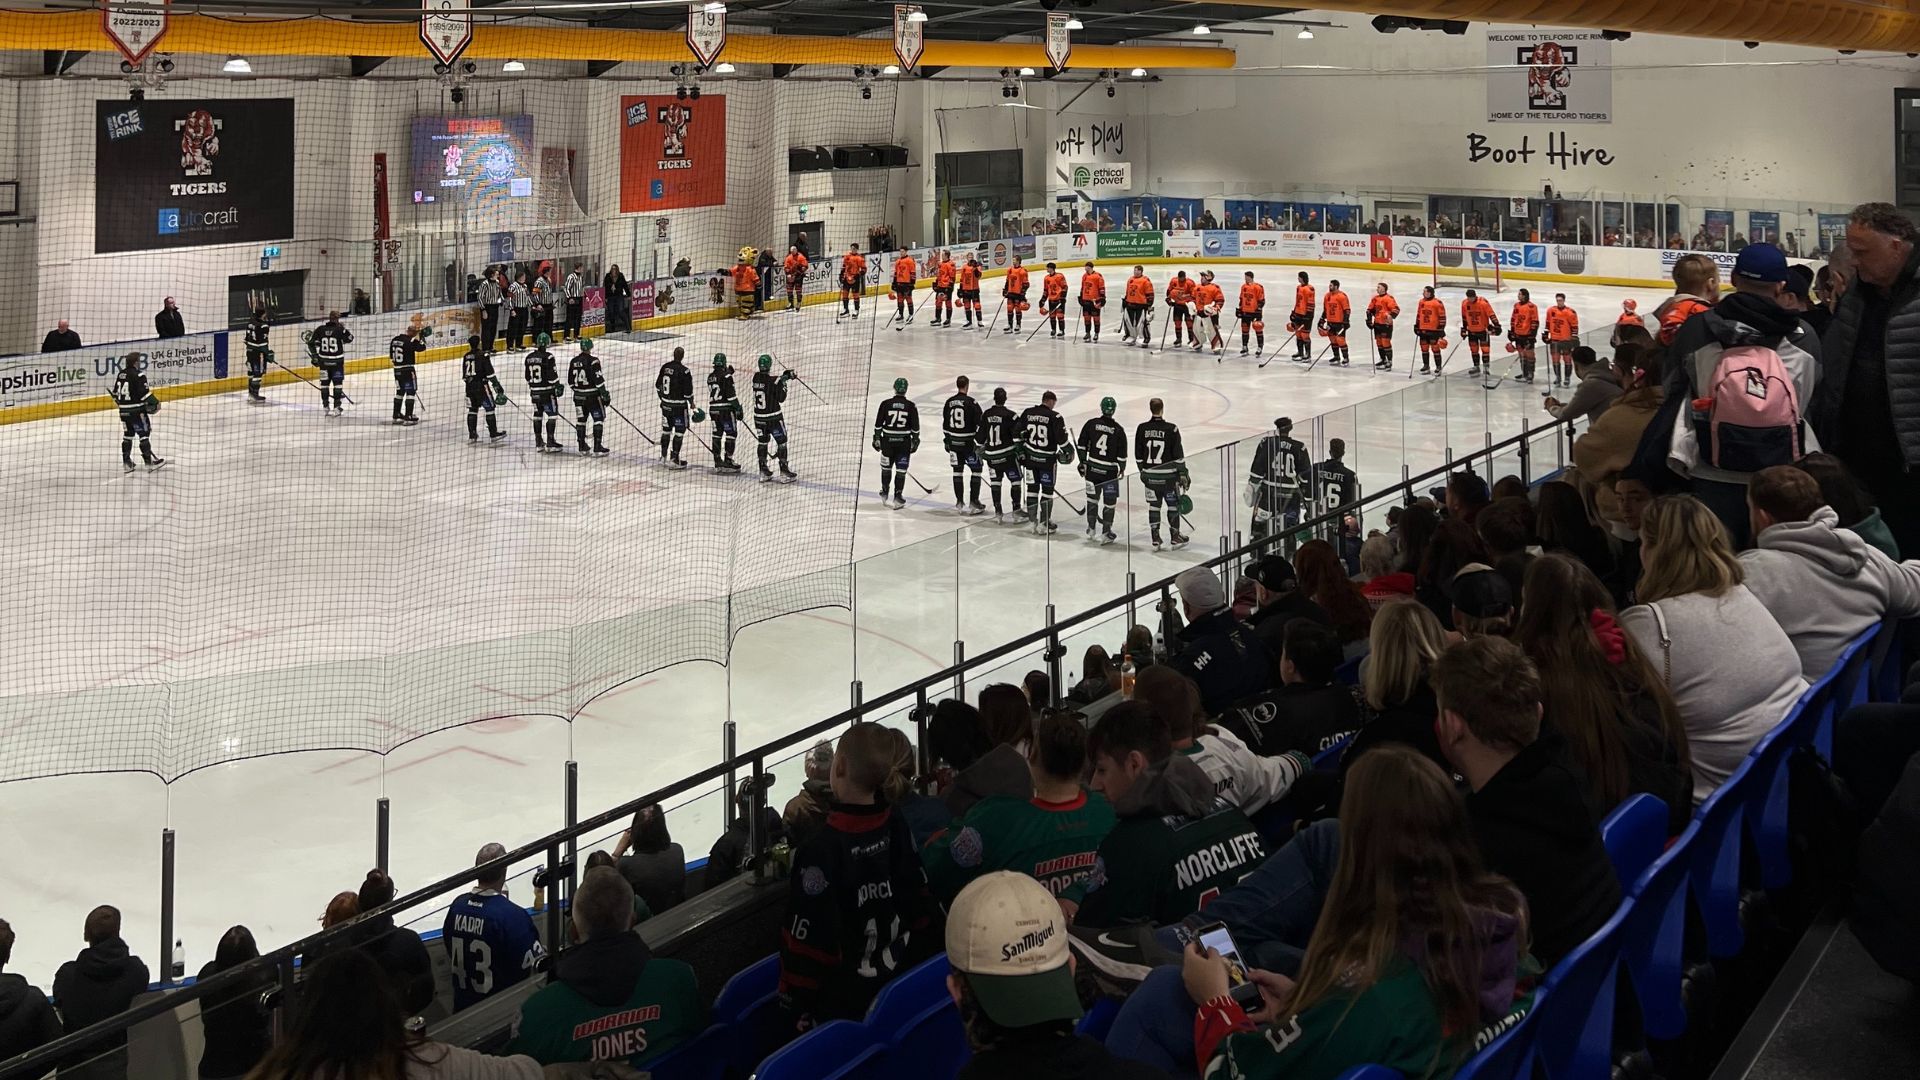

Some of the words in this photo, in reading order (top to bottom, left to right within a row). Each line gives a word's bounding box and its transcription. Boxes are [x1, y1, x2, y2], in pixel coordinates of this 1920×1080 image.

[113, 18, 160, 27] 2022/2023
[1488, 34, 1526, 42] WELCOME
[111, 109, 140, 129] ICE
[629, 102, 647, 118] ICE
[115, 121, 143, 139] RINK
[1056, 127, 1085, 157] oft
[1091, 121, 1124, 155] Play
[1466, 132, 1536, 163] Boot
[1545, 131, 1616, 170] Hire
[657, 159, 692, 170] TIGERS
[1093, 167, 1125, 177] ethical
[170, 181, 228, 196] TIGERS
[1093, 176, 1125, 187] power
[167, 206, 239, 229] autocraft
[501, 225, 584, 254] autocraft
[1099, 238, 1130, 247] Williams
[1131, 238, 1138, 246] &
[1140, 237, 1162, 246] Lamb
[1322, 239, 1341, 247] FIVE
[1343, 240, 1366, 248] GUYS
[1474, 243, 1523, 267] Gas
[151, 350, 165, 360] UK
[166, 349, 173, 358] &
[174, 345, 207, 358] Ireland
[151, 358, 185, 370] Testing
[186, 353, 213, 365] Board
[94, 353, 149, 377] UKB
[465, 360, 477, 377] 21
[528, 364, 543, 384] 13
[0, 366, 87, 395] pshirelive
[116, 381, 131, 401] 14
[753, 390, 767, 410] 3
[887, 410, 909, 428] 75
[949, 407, 966, 429] 19
[988, 424, 1003, 447] 11
[1026, 423, 1049, 447] 29
[1095, 433, 1109, 456] 4
[1146, 439, 1166, 465] 17
[1271, 451, 1297, 479] 40
[1193, 650, 1213, 671] HH
[1034, 850, 1098, 877] WARRIO
[1174, 831, 1266, 891] NORCLIFFE
[454, 913, 484, 936] KADRI
[791, 914, 810, 940] 16
[451, 937, 494, 995] 43
[572, 1004, 662, 1041] WARRIOR
[590, 1027, 648, 1063] JONES
